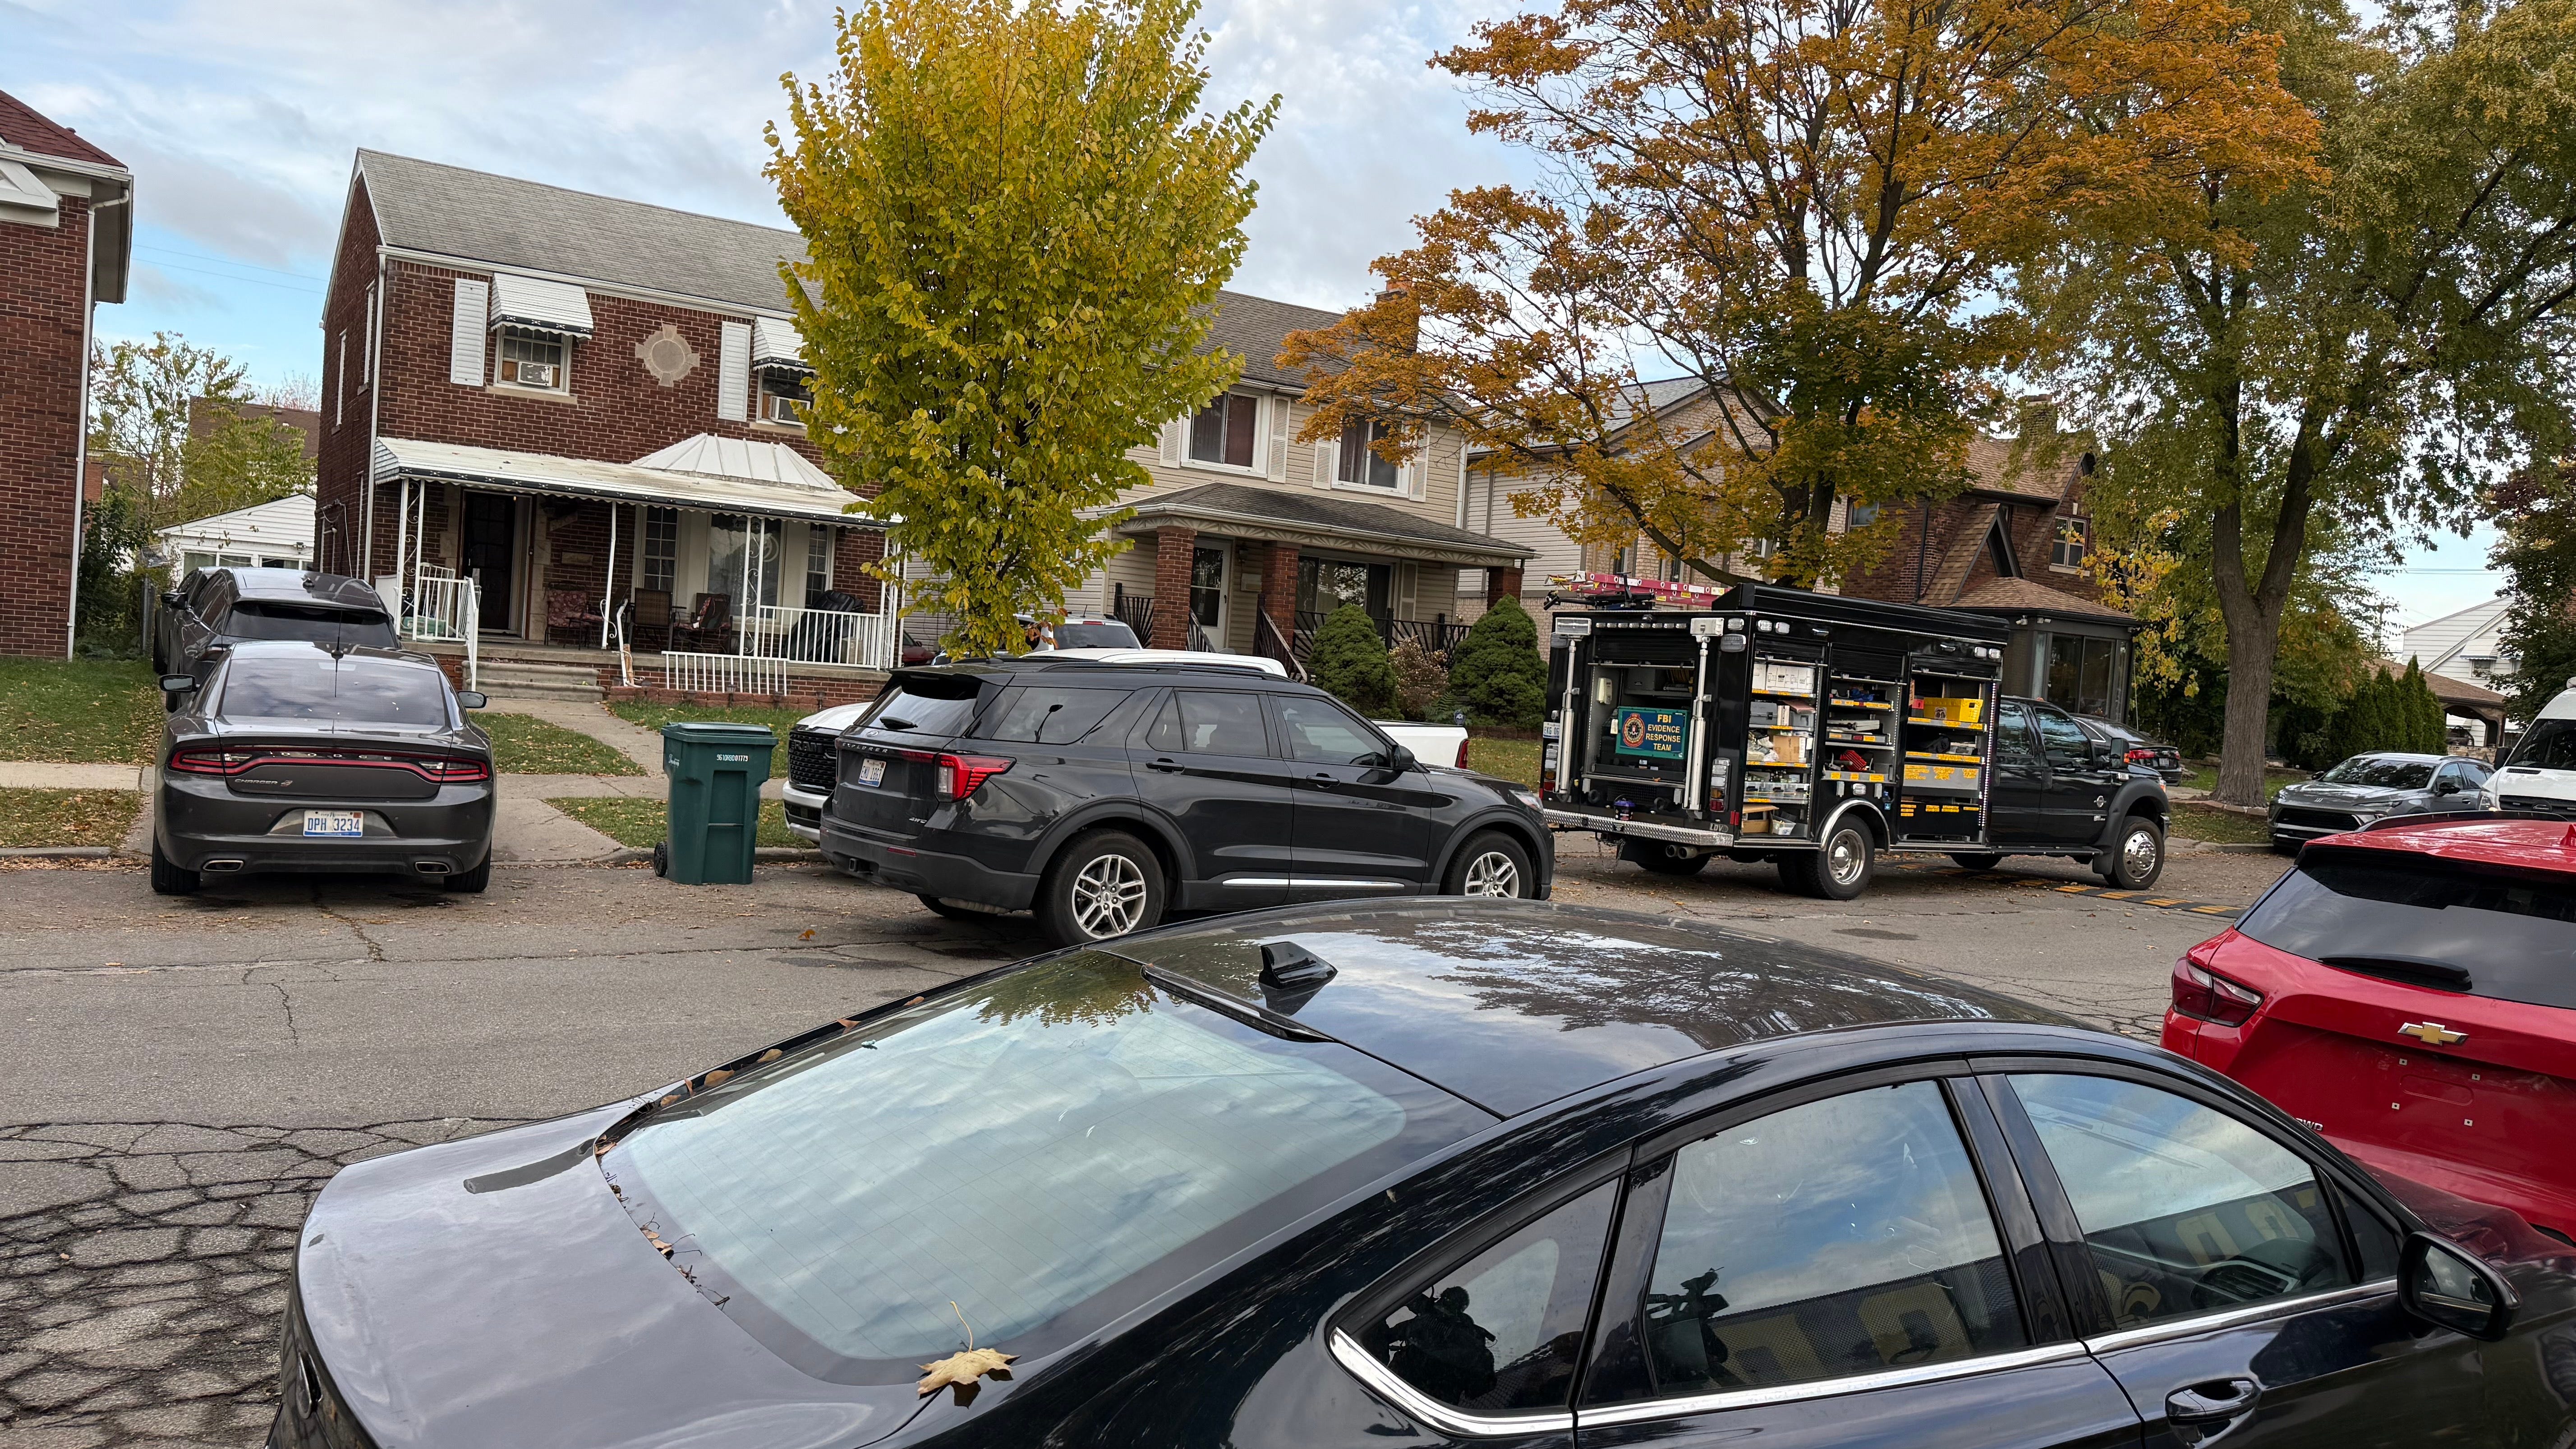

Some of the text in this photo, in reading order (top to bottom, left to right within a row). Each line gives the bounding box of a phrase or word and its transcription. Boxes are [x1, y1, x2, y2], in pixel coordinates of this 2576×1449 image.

[1657, 714, 1671, 723] FBI
[1647, 724, 1680, 733] EVIDENCE
[1646, 733, 1681, 742] RESPONSE
[795, 740, 823, 754] RAM
[842, 742, 888, 753] EXPLORER
[308, 818, 360, 832] DPH 3234
[1710, 823, 1723, 832] LDV
